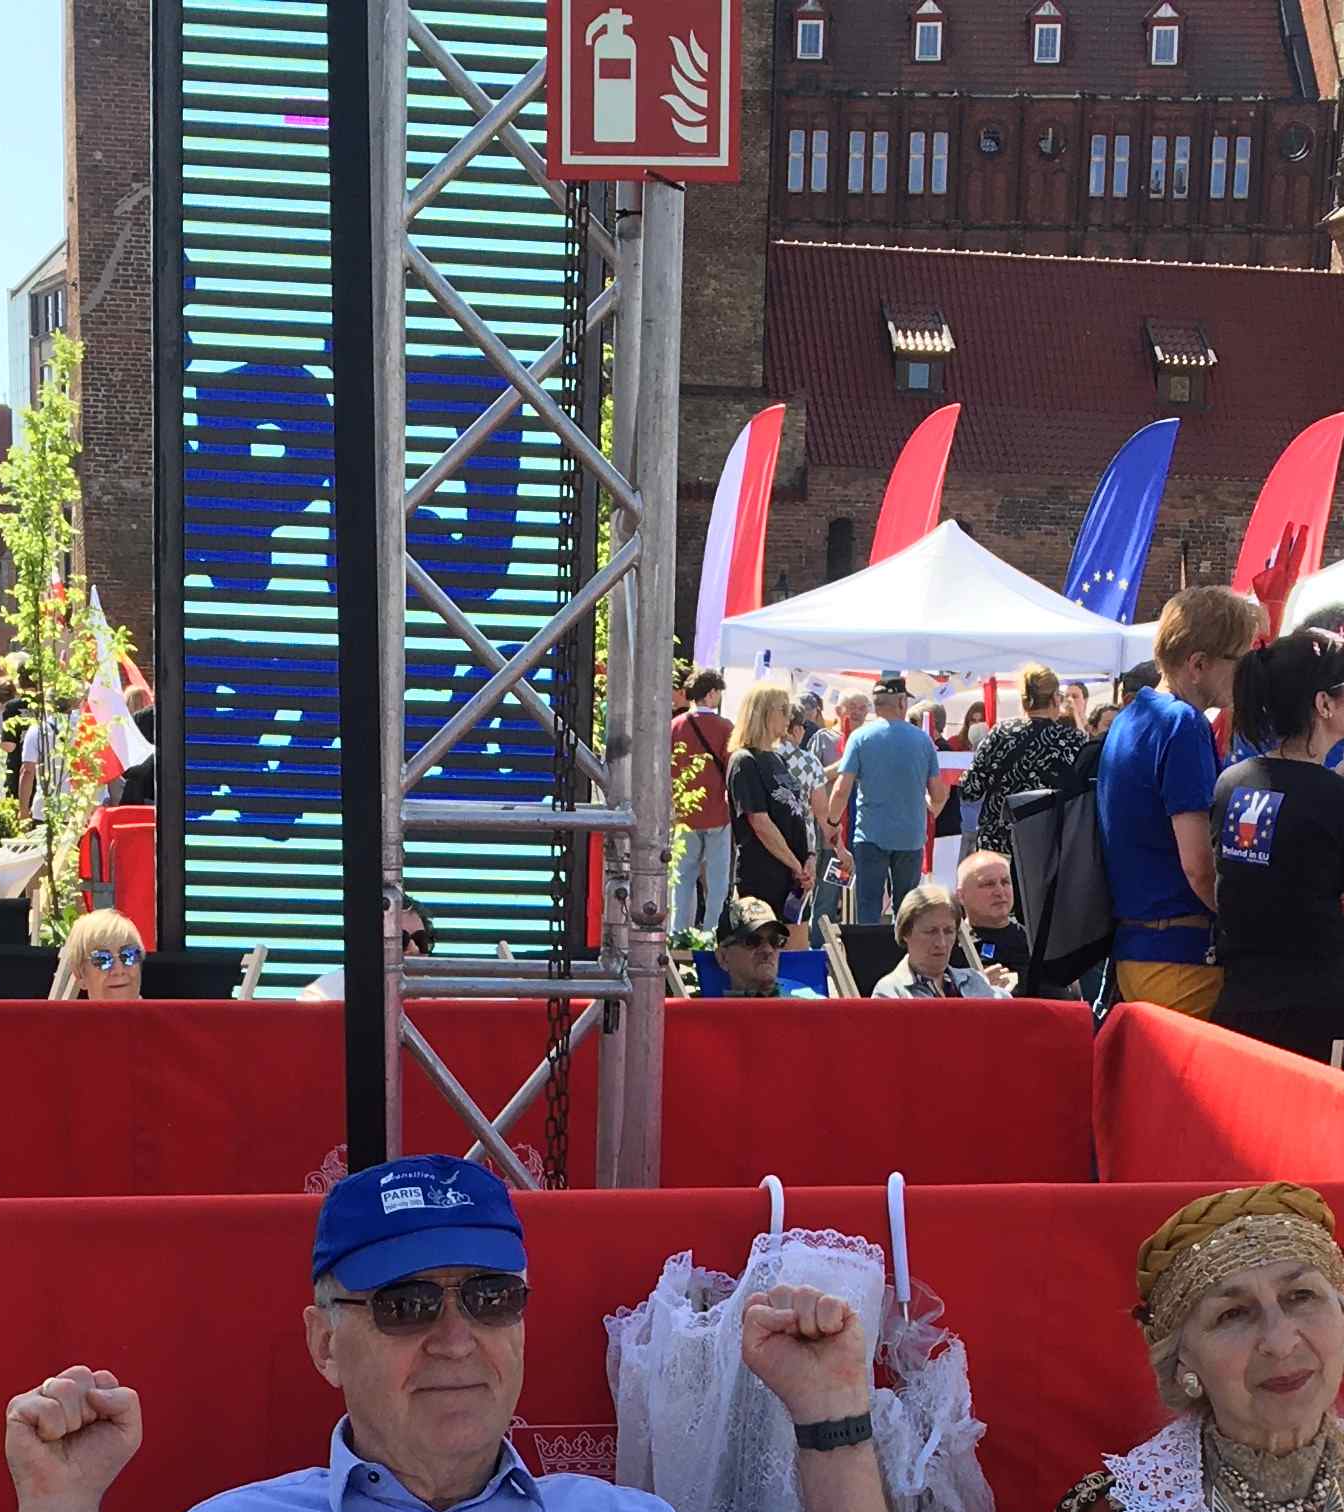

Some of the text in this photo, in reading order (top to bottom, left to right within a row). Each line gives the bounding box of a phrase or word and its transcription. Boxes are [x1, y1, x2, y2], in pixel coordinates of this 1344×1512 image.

[1222, 844, 1270, 861] Poland in EU
[383, 1188, 421, 1202] PARIS
